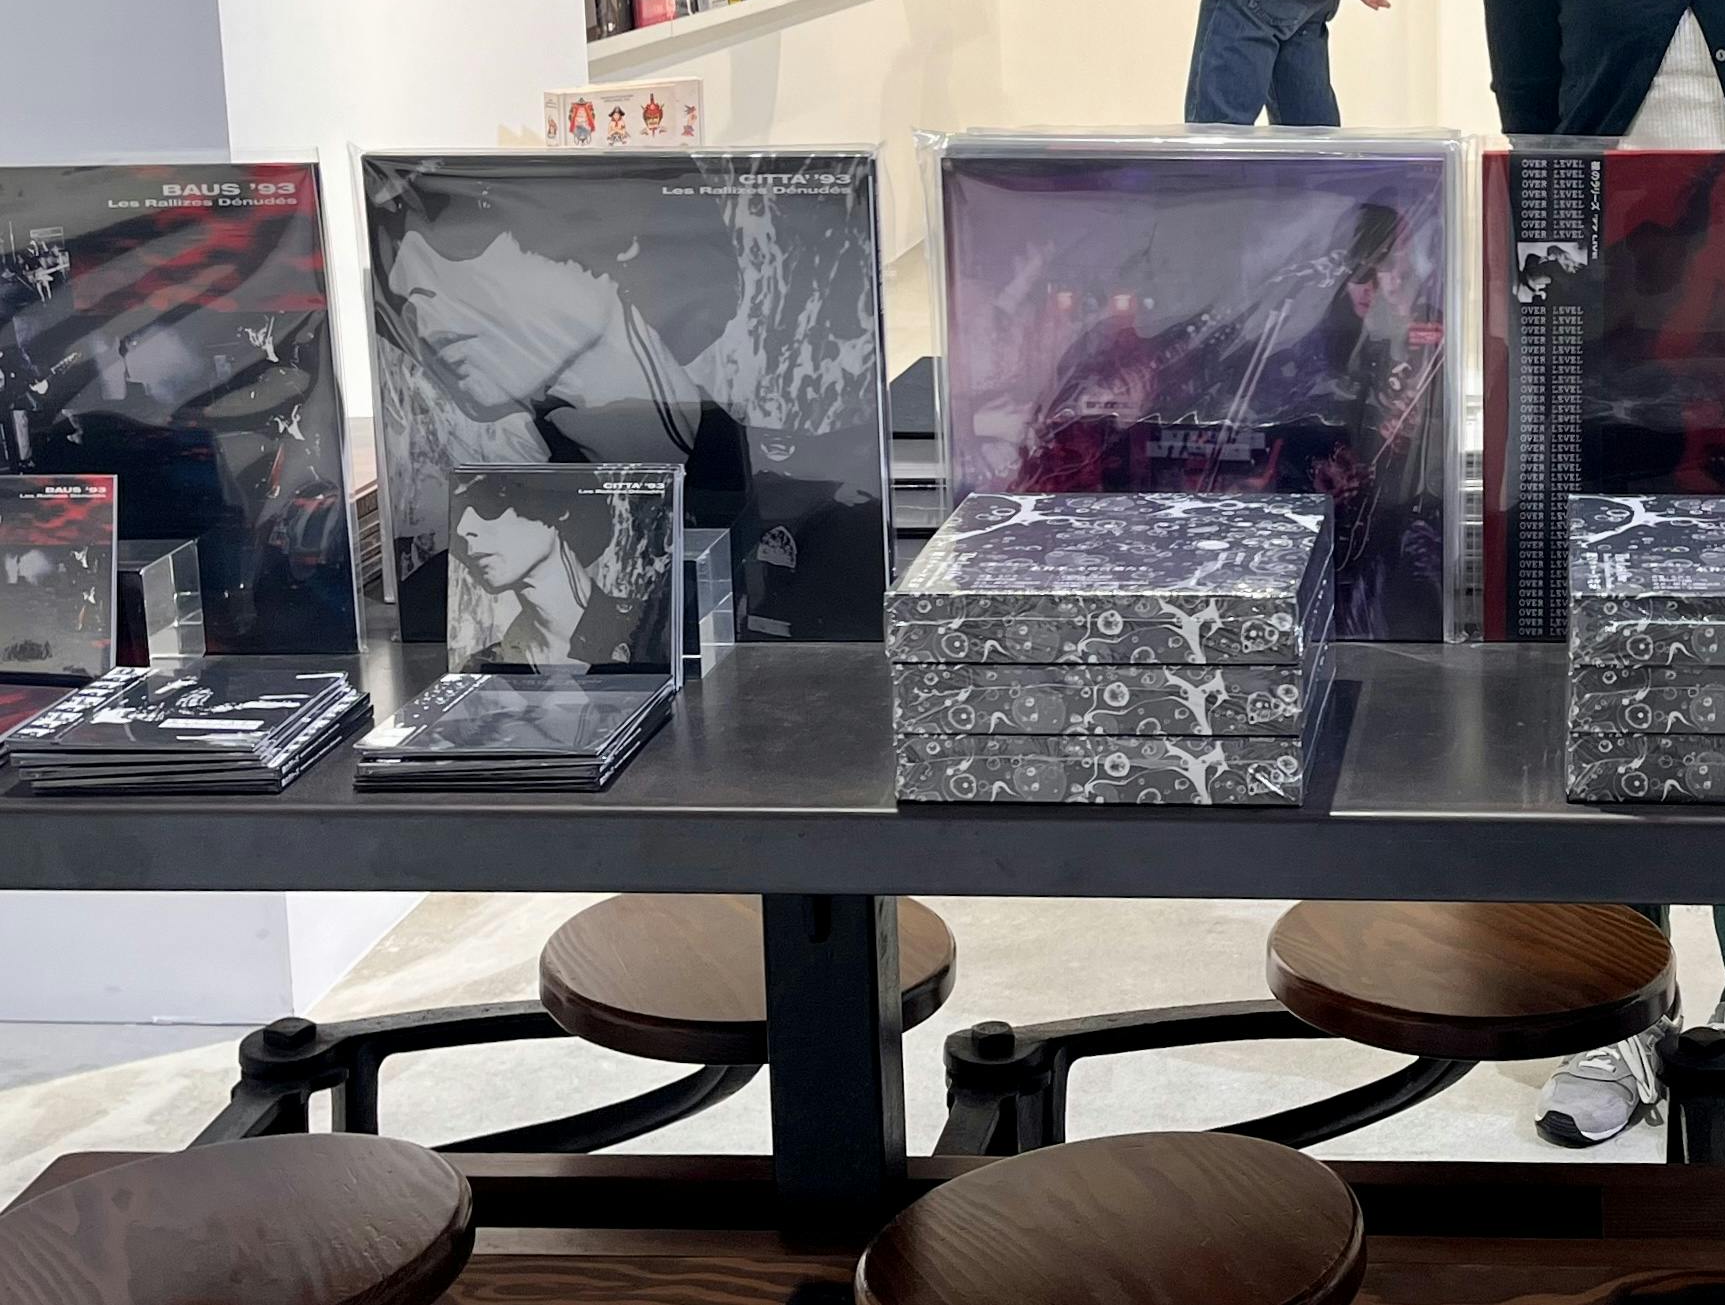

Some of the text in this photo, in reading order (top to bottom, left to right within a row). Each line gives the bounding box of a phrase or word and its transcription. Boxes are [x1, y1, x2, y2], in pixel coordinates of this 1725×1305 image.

[1522, 160, 1584, 168] OVER LEVEL
[1521, 170, 1584, 178] OVER LEVEL
[814, 174, 851, 184] '93
[1521, 180, 1584, 188] OVER LEVEL
[162, 183, 296, 196] BAUS '93
[662, 186, 851, 195] Les Rallizes Dénudés
[1521, 190, 1584, 198] OVER LEVEL
[108, 197, 297, 208] Les Rallizes Dénudés
[1521, 200, 1584, 208] OVER LEVEL
[1521, 210, 1584, 218] OVER LEVEL
[1521, 220, 1584, 228] OVER LEVEL
[1521, 230, 1584, 238] OVER LEVEL
[1521, 306, 1583, 314] OVER LEVEL
[1521, 316, 1583, 324] OVER LEVEL
[1521, 326, 1583, 334] OVER LEVEL
[1521, 336, 1583, 344] OVER LEVEL
[1521, 346, 1583, 354] OVER LEVEL
[1521, 415, 1582, 423] OVER LEVEL
[1520, 444, 1582, 452] OVER LEVEL
[1520, 454, 1582, 462] OVER LEVEL
[1520, 483, 1582, 491] OVER LEVEL
[1520, 512, 1544, 520] OVER
[1520, 541, 1544, 549] OVER
[1520, 570, 1544, 578] OVER
